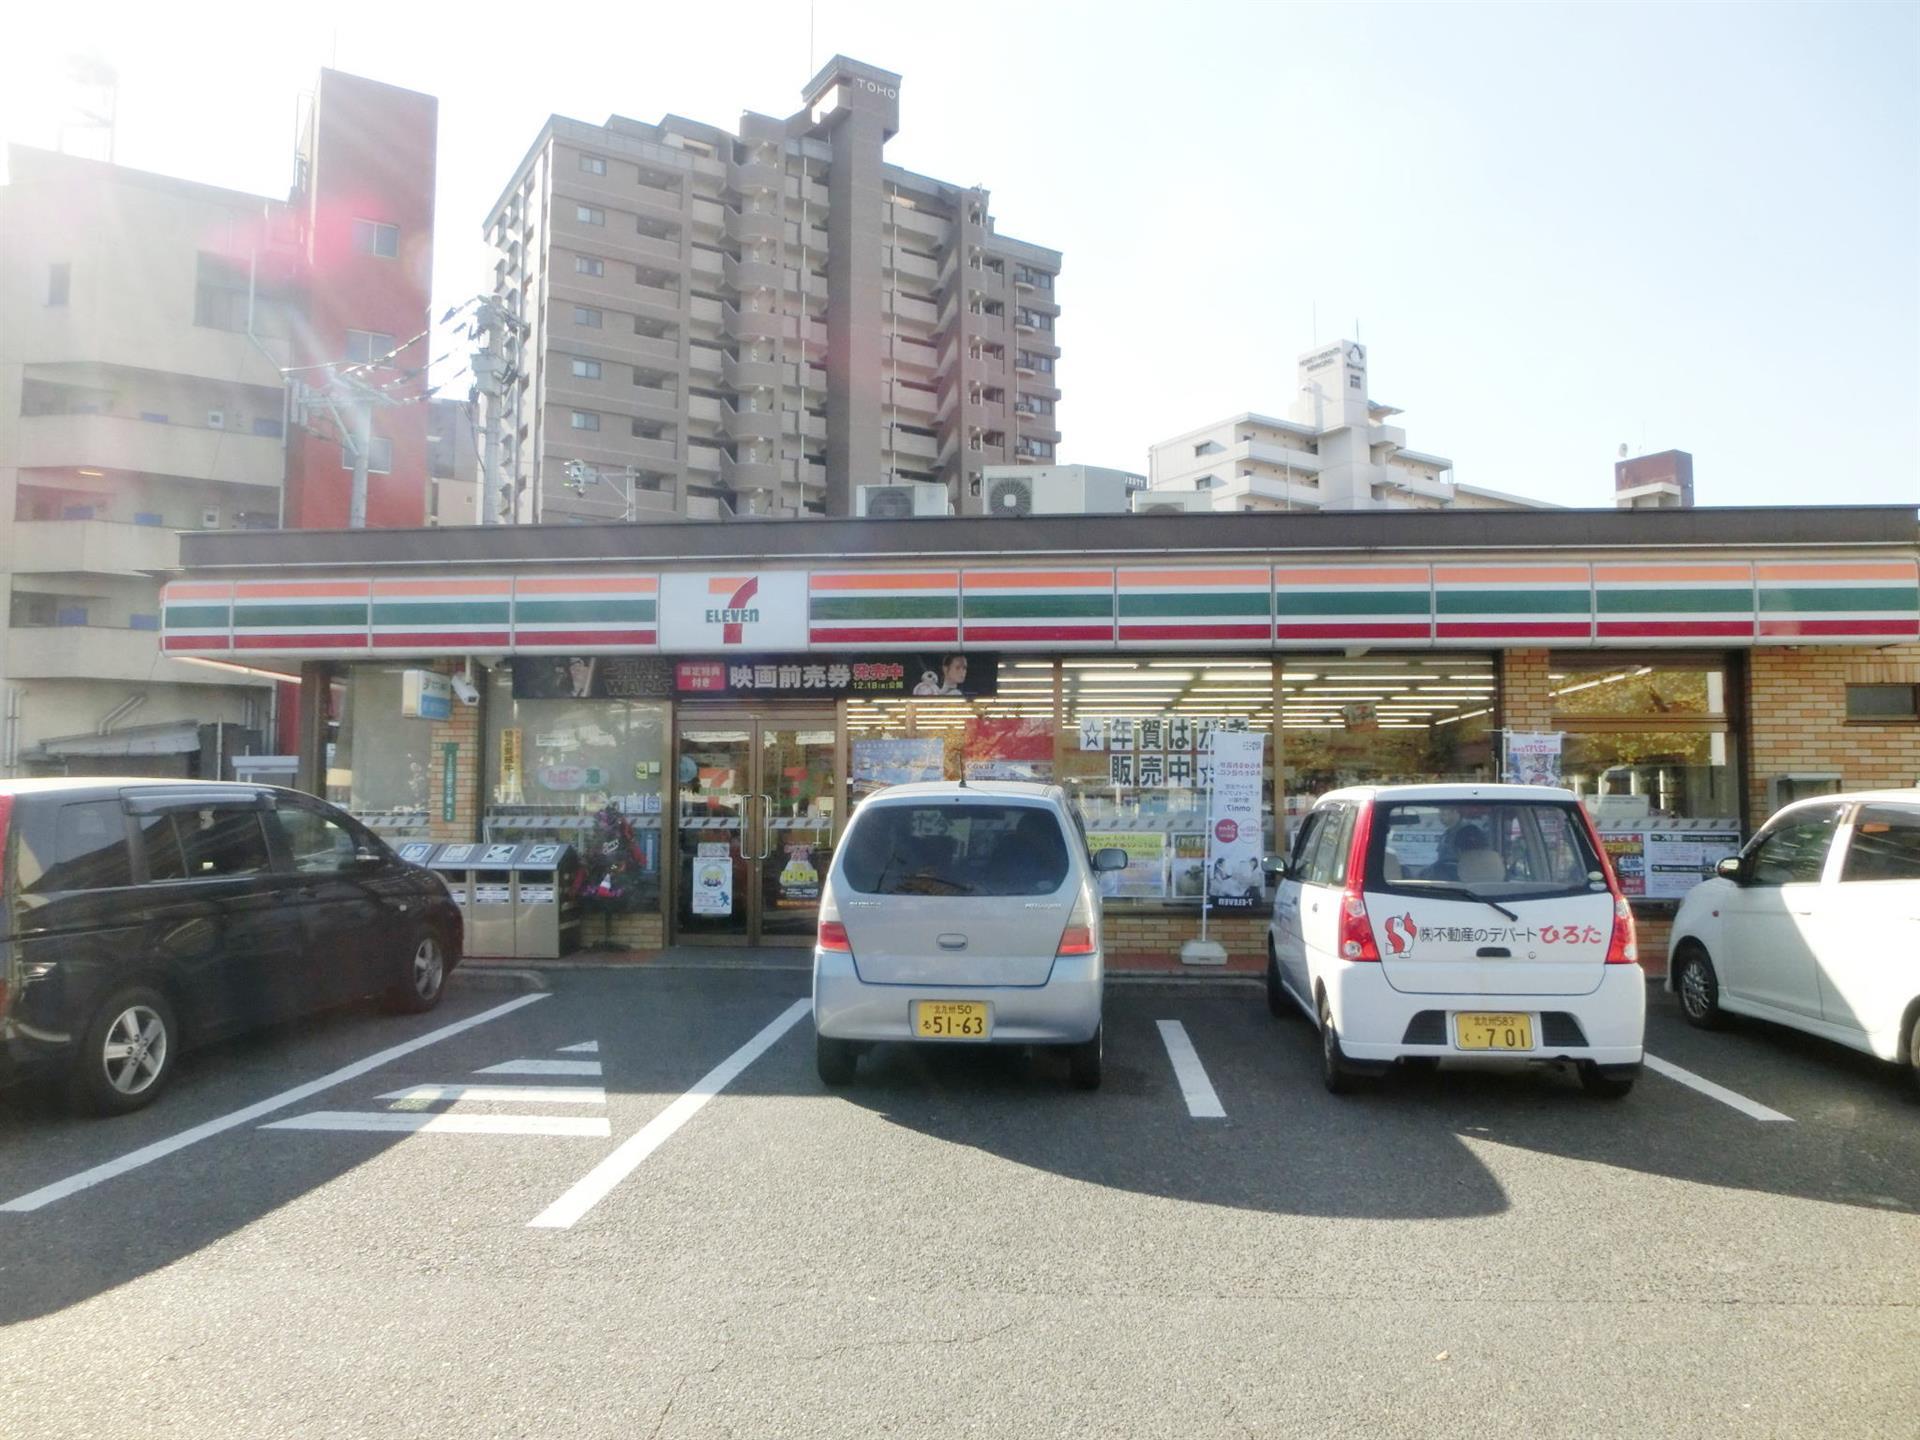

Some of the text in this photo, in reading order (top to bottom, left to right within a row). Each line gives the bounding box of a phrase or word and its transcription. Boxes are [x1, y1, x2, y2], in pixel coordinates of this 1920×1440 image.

[857, 78, 896, 100] TOHO
[729, 665, 851, 689] 映画前売券
[853, 664, 904, 681] 発売中
[605, 679, 672, 695] WARS
[1110, 756, 1191, 786] 販売中
[1539, 925, 1602, 944] ひろた
[933, 1016, 983, 1035] 51-63
